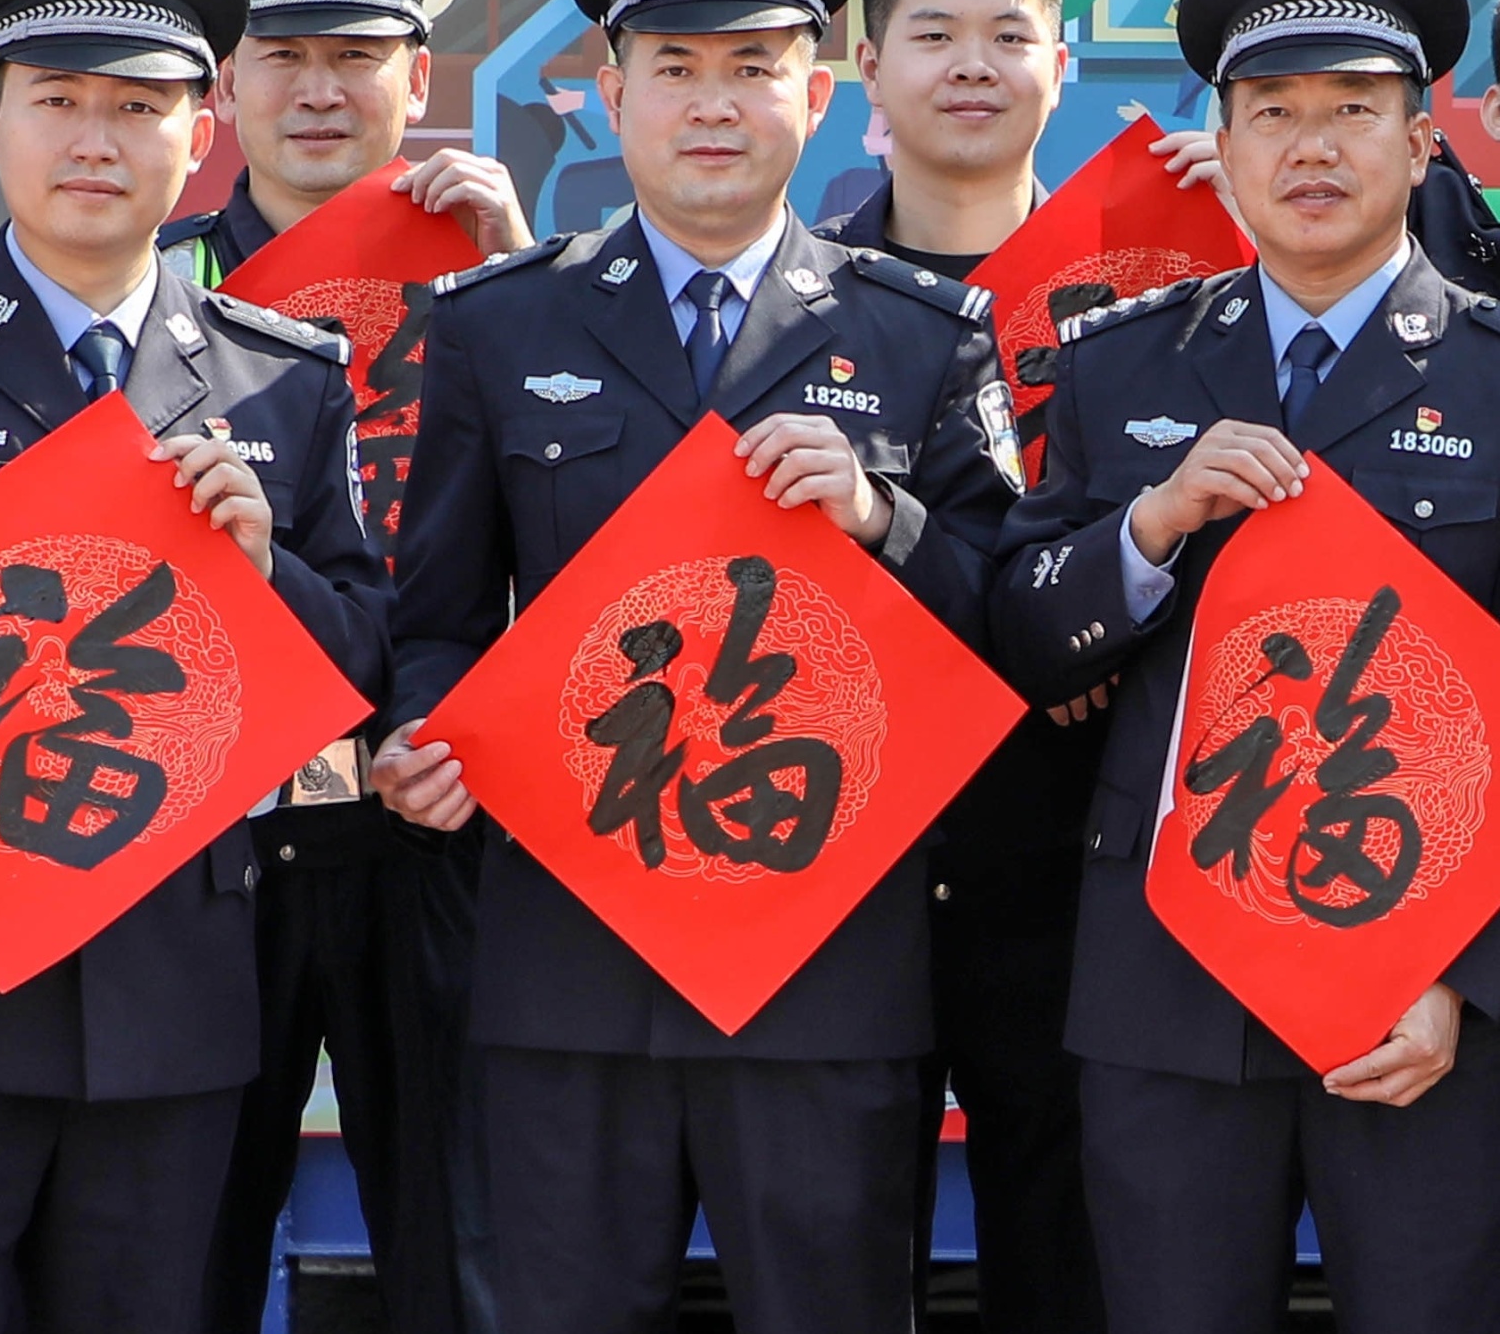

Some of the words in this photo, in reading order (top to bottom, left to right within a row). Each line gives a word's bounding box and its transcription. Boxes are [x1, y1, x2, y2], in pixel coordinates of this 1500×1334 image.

[803, 383, 881, 415] 182692
[1389, 428, 1474, 460] 183060
[583, 553, 844, 873] 福
[1184, 585, 1423, 929] 福
